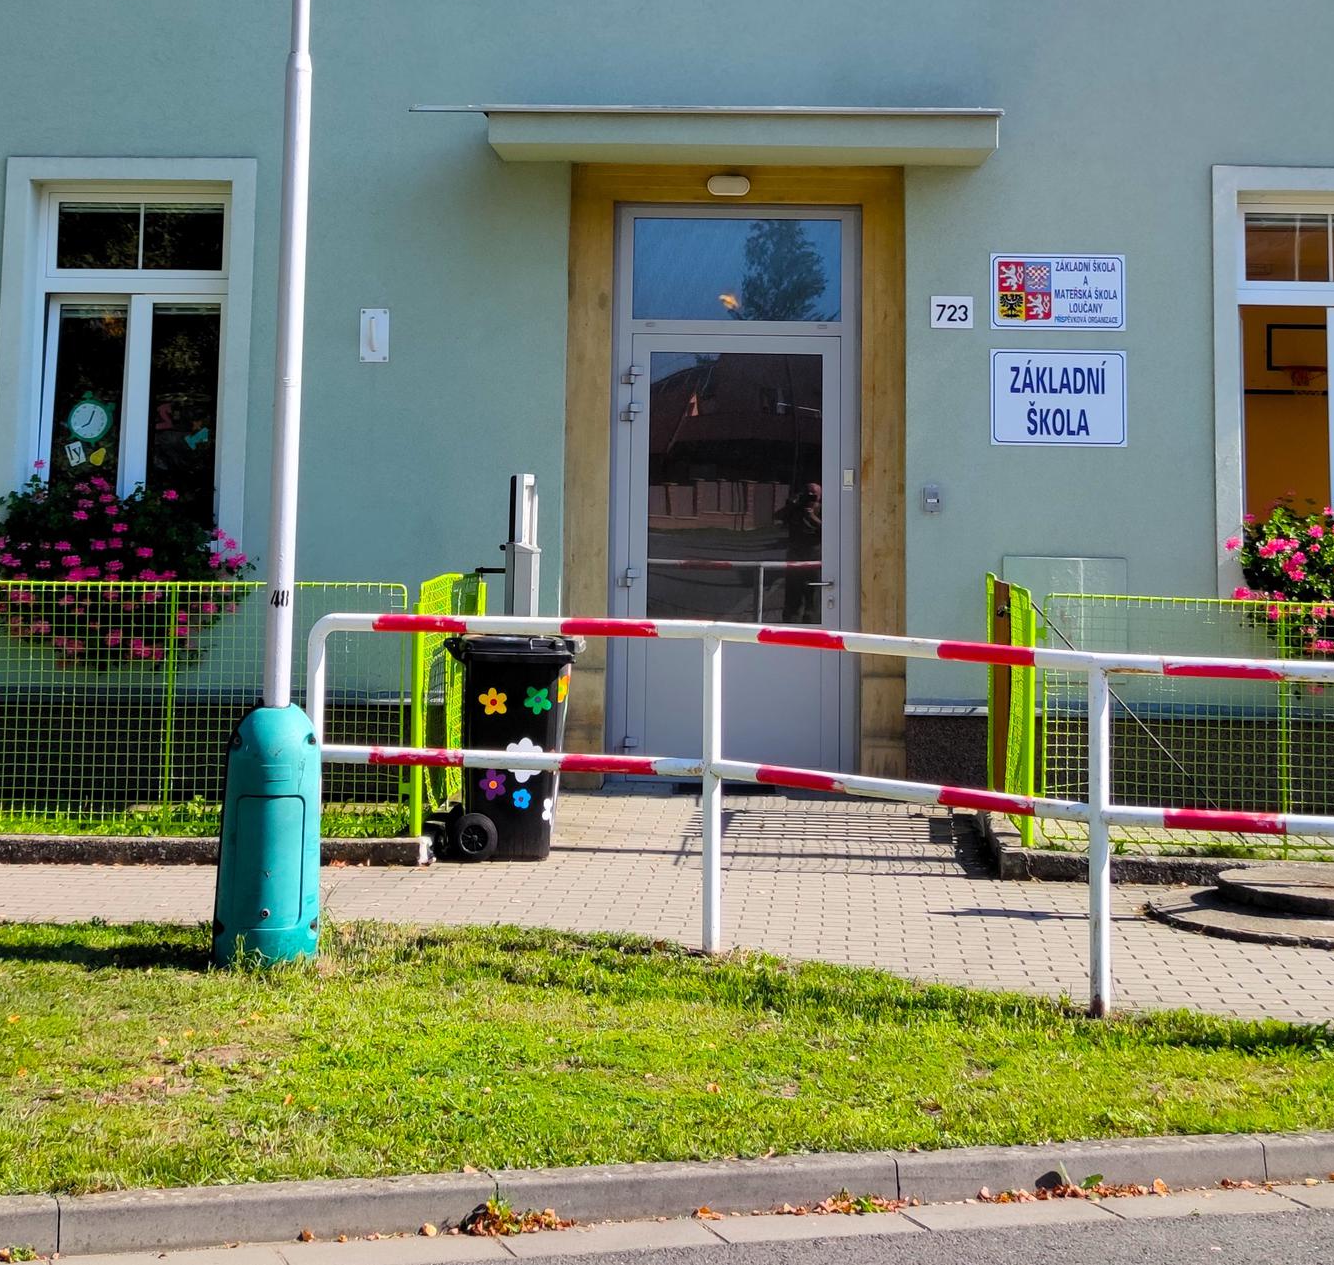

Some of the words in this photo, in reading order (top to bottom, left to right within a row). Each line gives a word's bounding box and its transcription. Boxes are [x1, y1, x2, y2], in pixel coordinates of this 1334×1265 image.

[1055, 259, 1091, 272] ZÁKLADNÍ
[1092, 259, 1116, 272] ŠKOLA
[1083, 275, 1089, 286] A
[1054, 286, 1092, 300] MATEŘSKÁ
[1094, 286, 1118, 300] ŠKOLA
[935, 304, 969, 322] 723
[1010, 360, 1107, 395] ZÁKLADNÍ
[1027, 401, 1090, 436] ŠKOLA
